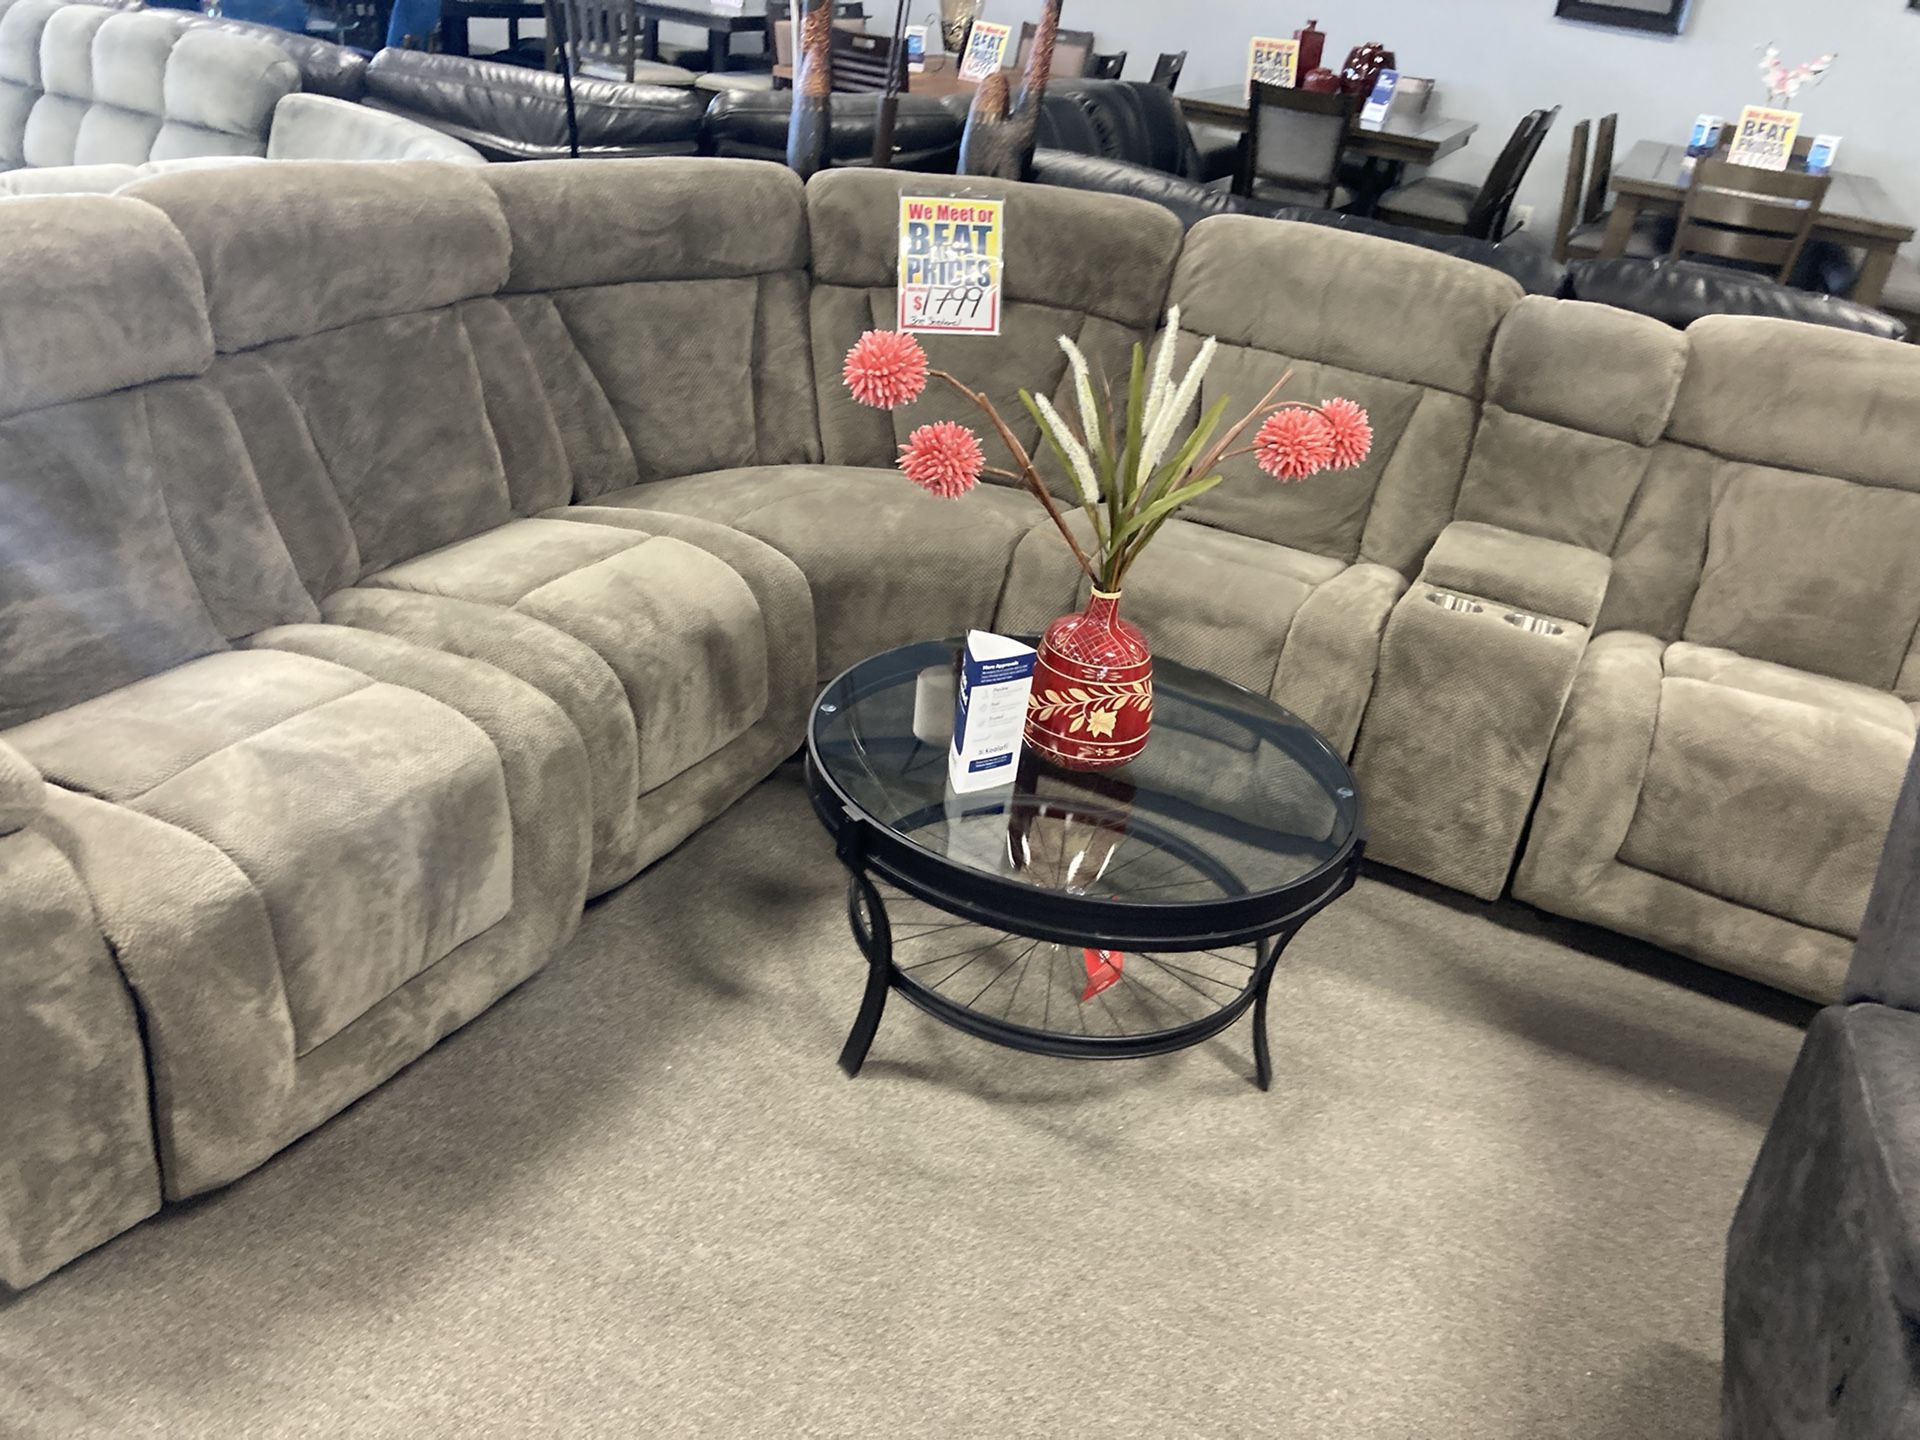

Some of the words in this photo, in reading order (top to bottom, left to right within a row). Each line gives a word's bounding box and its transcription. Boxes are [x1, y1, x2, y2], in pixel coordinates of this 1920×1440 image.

[908, 203, 933, 220] We
[936, 205, 974, 221] Meet
[977, 208, 994, 223] or
[907, 222, 993, 256] BEAT
[907, 257, 992, 287] PRICES
